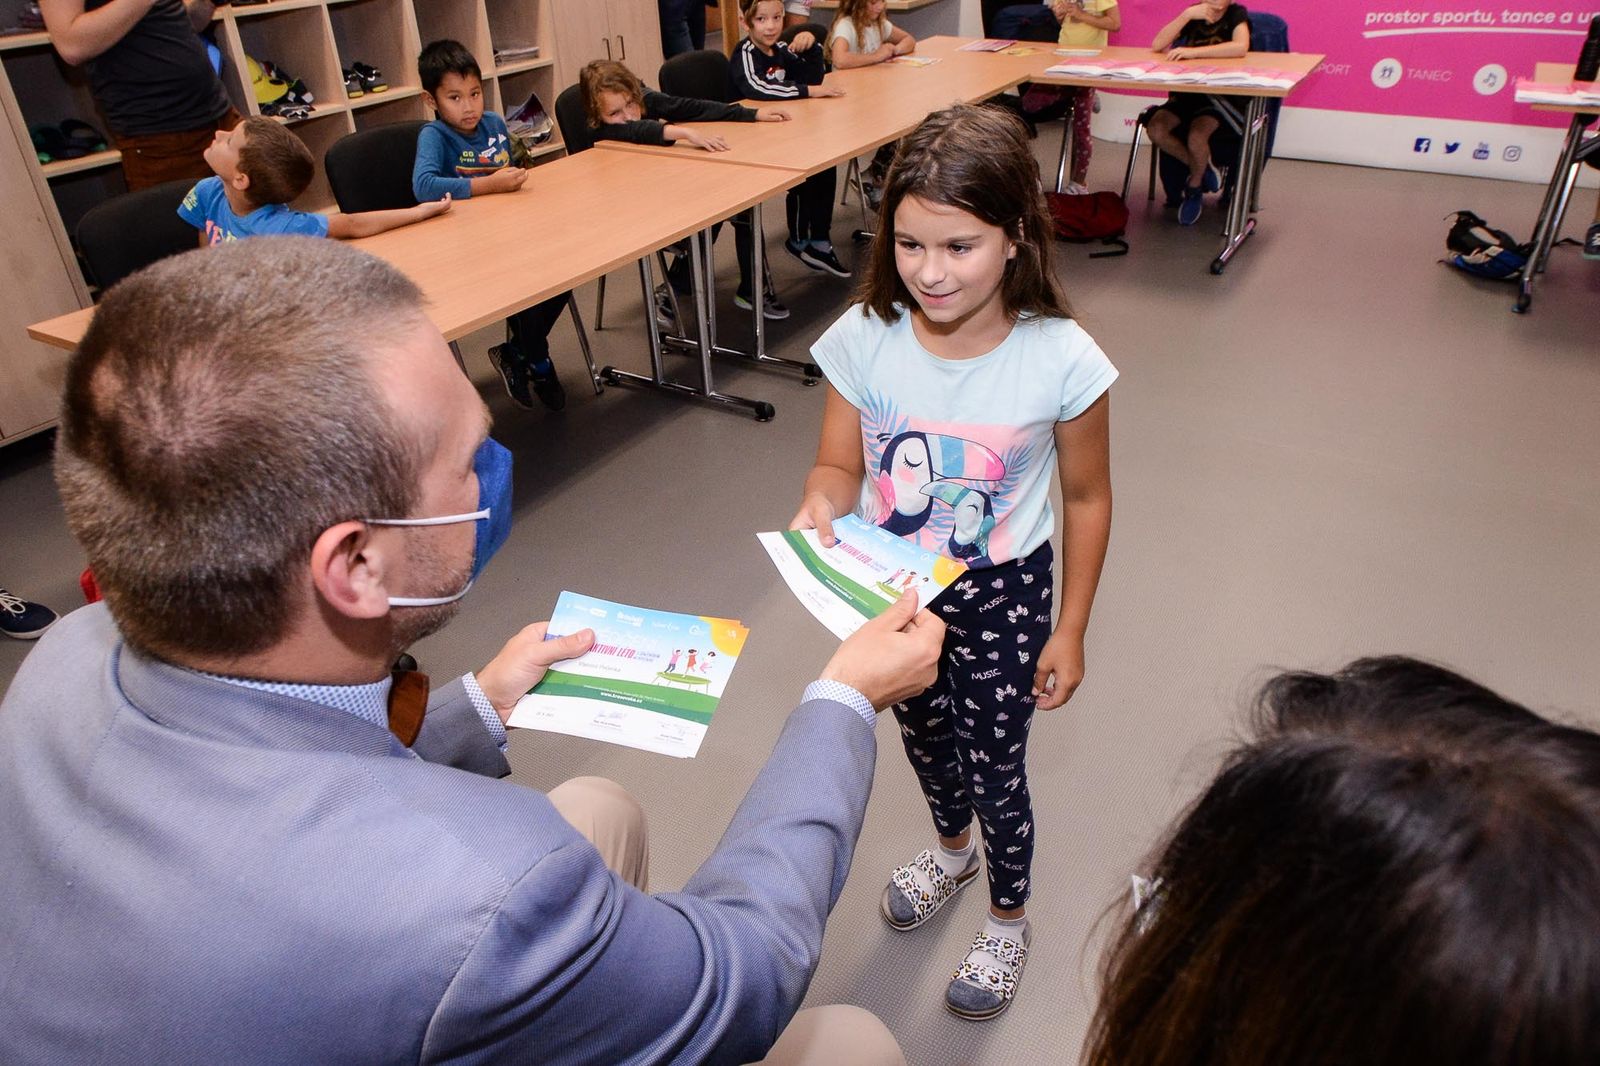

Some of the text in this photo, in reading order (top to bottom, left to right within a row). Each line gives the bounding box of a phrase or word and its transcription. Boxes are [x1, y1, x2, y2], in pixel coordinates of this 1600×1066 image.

[1365, 10, 1430, 26] prostor
[1432, 9, 1496, 26] sportu,
[1501, 10, 1555, 24] tance
[1559, 11, 1574, 24] a
[1313, 63, 1351, 78] PORT
[1406, 68, 1453, 83] TANEC
[978, 595, 1009, 613] MUSIC
[971, 668, 1002, 681] MUSIC
